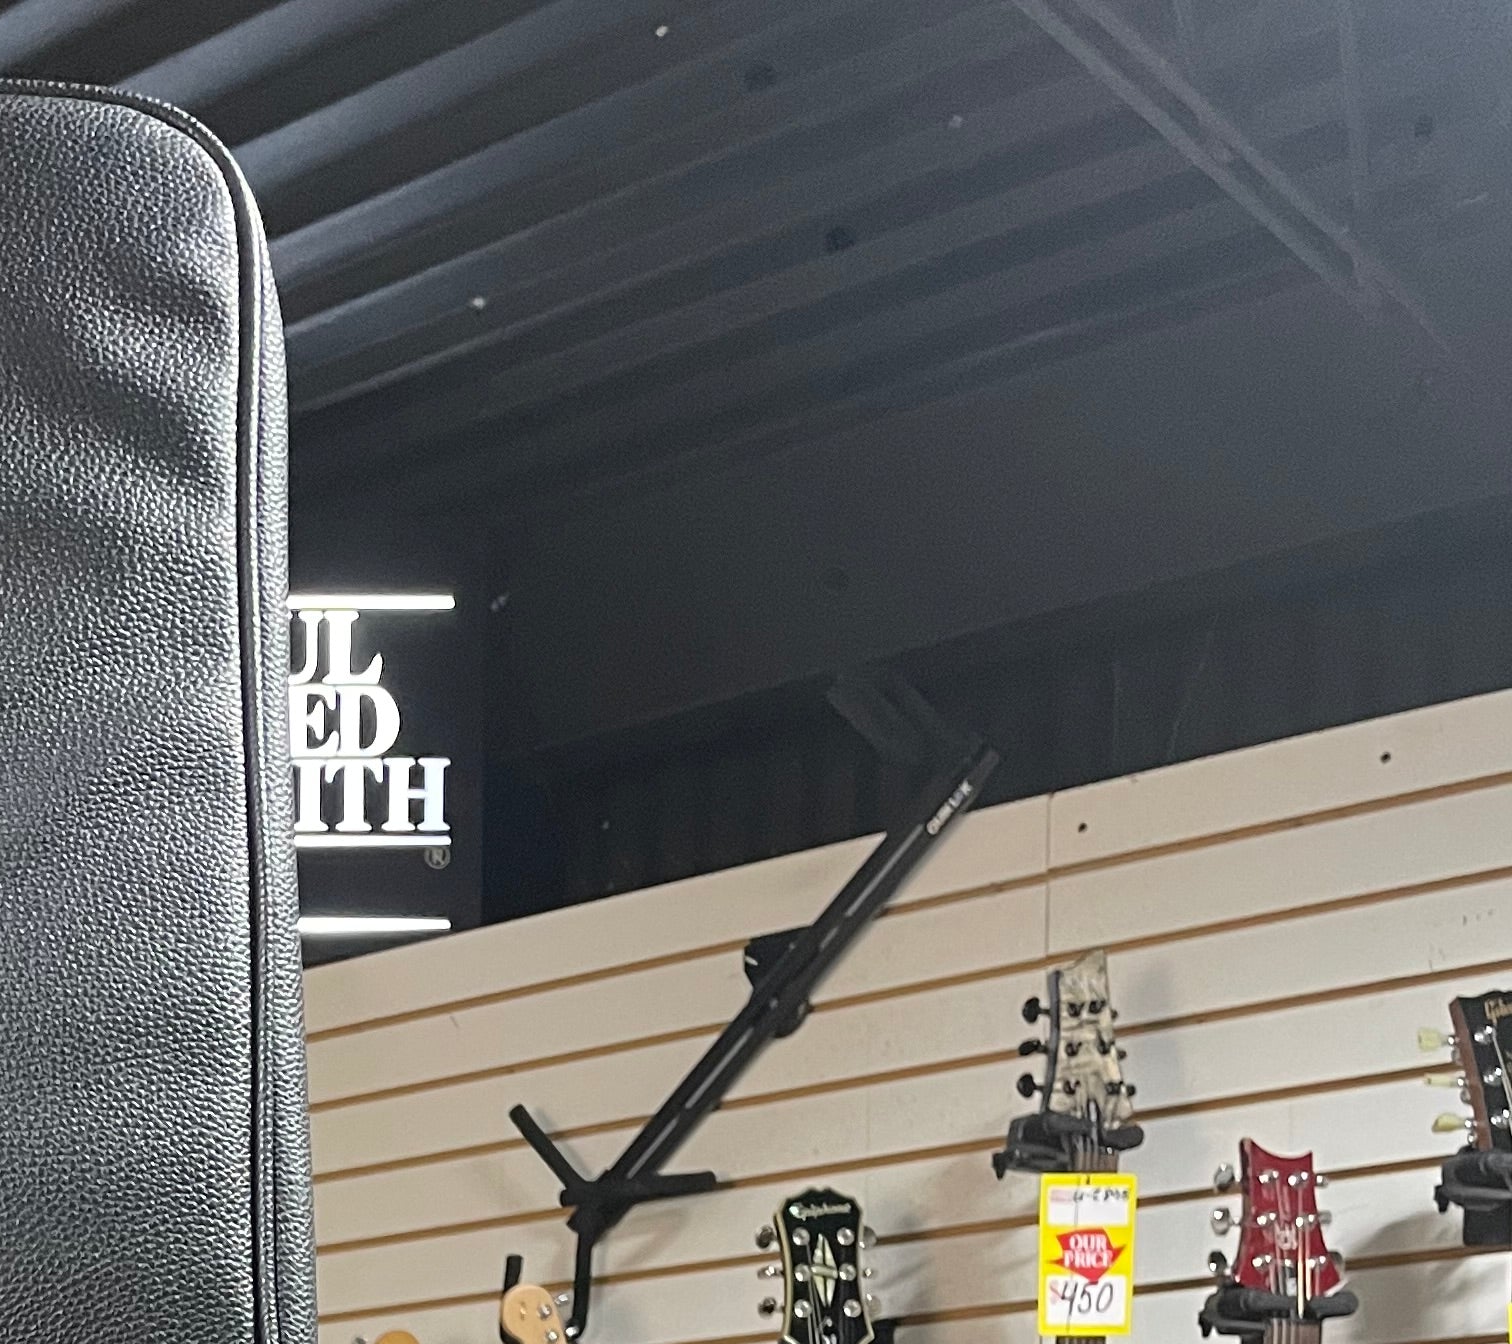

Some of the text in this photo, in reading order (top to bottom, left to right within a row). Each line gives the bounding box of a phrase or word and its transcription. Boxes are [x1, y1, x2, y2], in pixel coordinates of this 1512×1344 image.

[291, 757, 451, 832] ITH
[1069, 1234, 1107, 1251] OUR
[1064, 1250, 1113, 1268] PRICE
